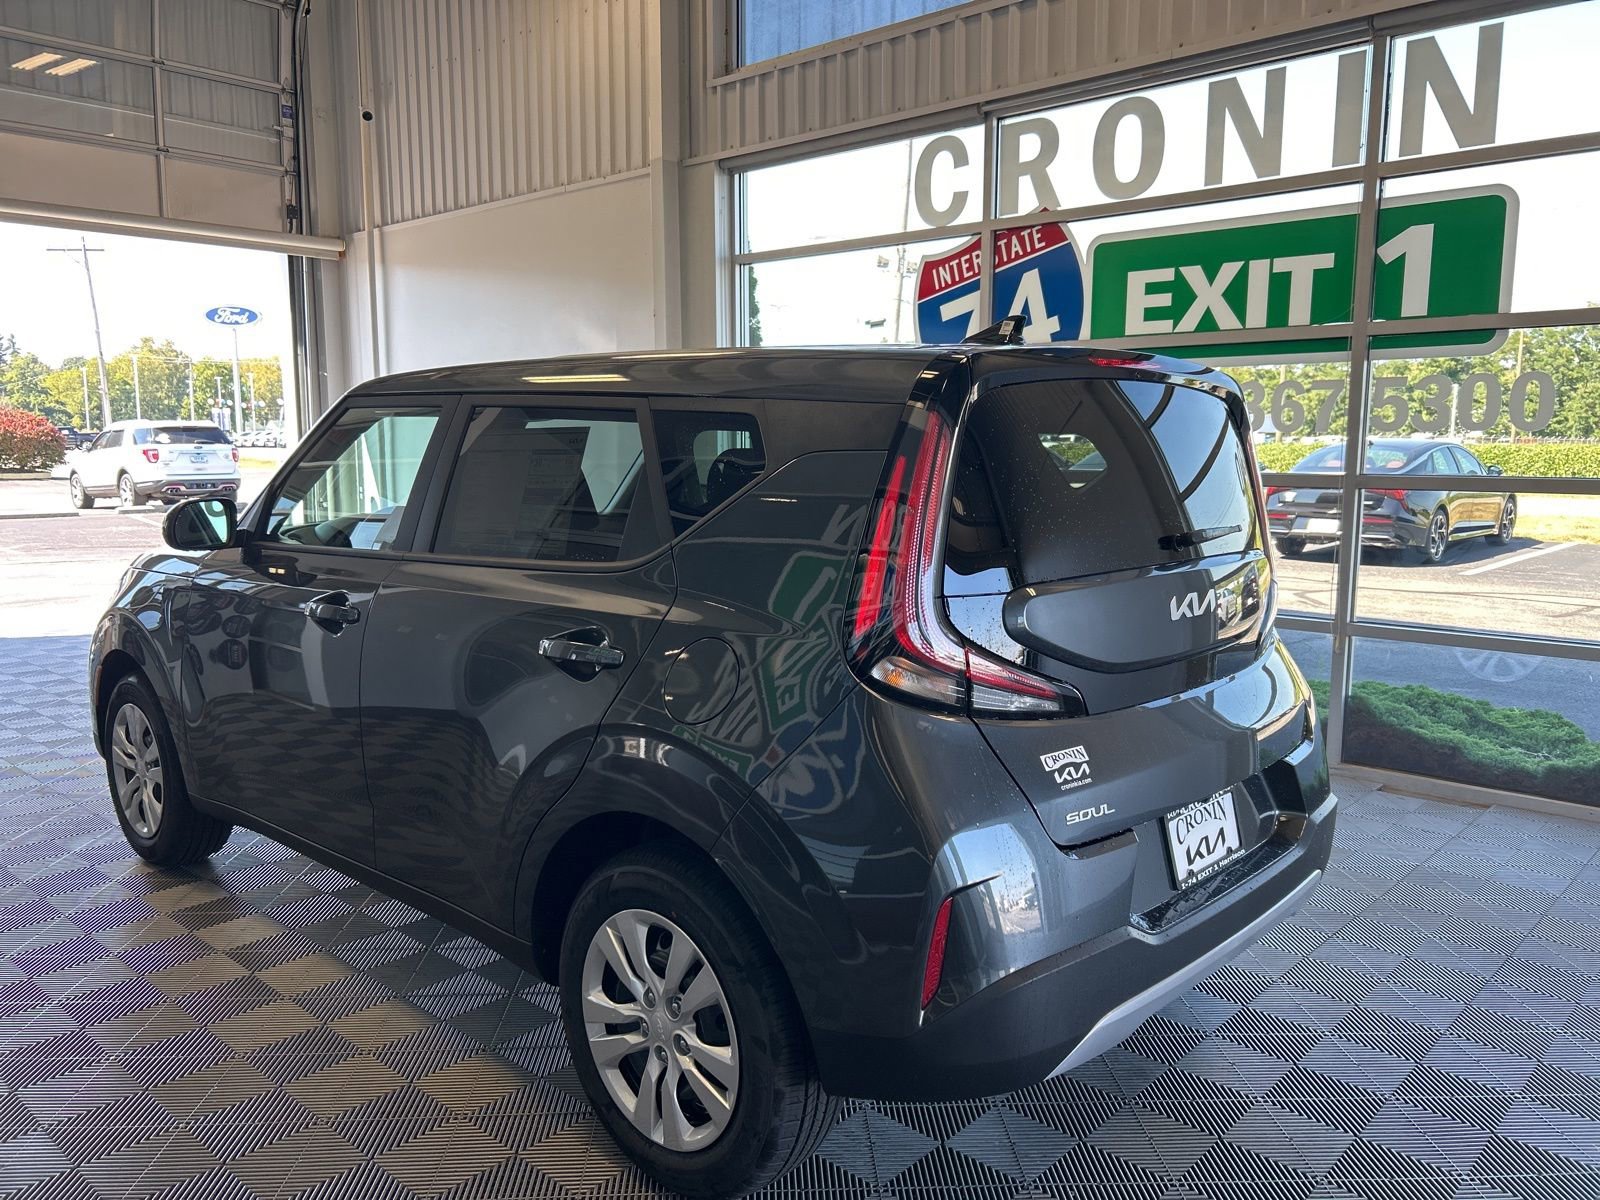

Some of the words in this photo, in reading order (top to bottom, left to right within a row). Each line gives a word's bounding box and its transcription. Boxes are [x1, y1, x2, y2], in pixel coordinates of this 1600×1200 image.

[914, 21, 1505, 227] CRONIN
[932, 225, 1046, 290] INTERTATE
[1124, 252, 1334, 336] EXIT
[1377, 223, 1435, 318] 1
[214, 307, 249, 324] Ford
[1170, 589, 1216, 621] KIA
[1044, 747, 1087, 769] CRONIN
[1054, 762, 1090, 784] KIA
[1066, 803, 1116, 825] SOUL
[1176, 797, 1227, 845] CRONIN
[1185, 826, 1226, 867] KIA
[1181, 877, 1197, 890] I-74
[1197, 866, 1213, 882] EXIT
[1219, 849, 1246, 867] Harrison
